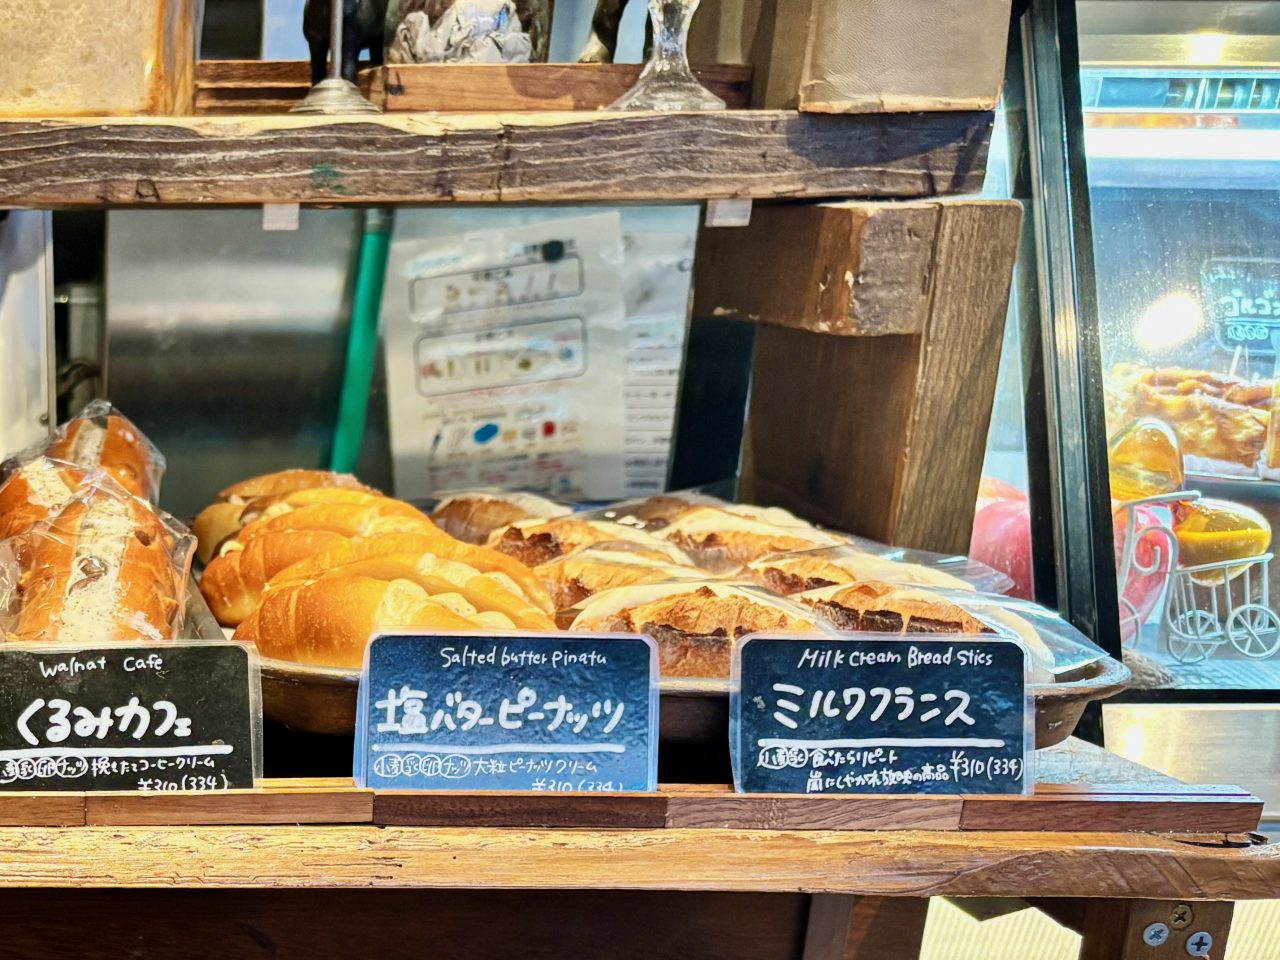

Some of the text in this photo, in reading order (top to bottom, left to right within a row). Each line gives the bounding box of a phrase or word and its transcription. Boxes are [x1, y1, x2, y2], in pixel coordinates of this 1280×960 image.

[123, 654, 163, 672] Cafe
[440, 645, 497, 668] Salted
[797, 648, 845, 668] Milk
[908, 646, 954, 668] Bread
[957, 649, 993, 666] Stics
[17, 696, 192, 746] くるみカフェ
[375, 685, 625, 734] 塩バターピーナッツ
[773, 683, 975, 728] ミルクフランス
[949, 750, 1024, 782] ¥310(334)
